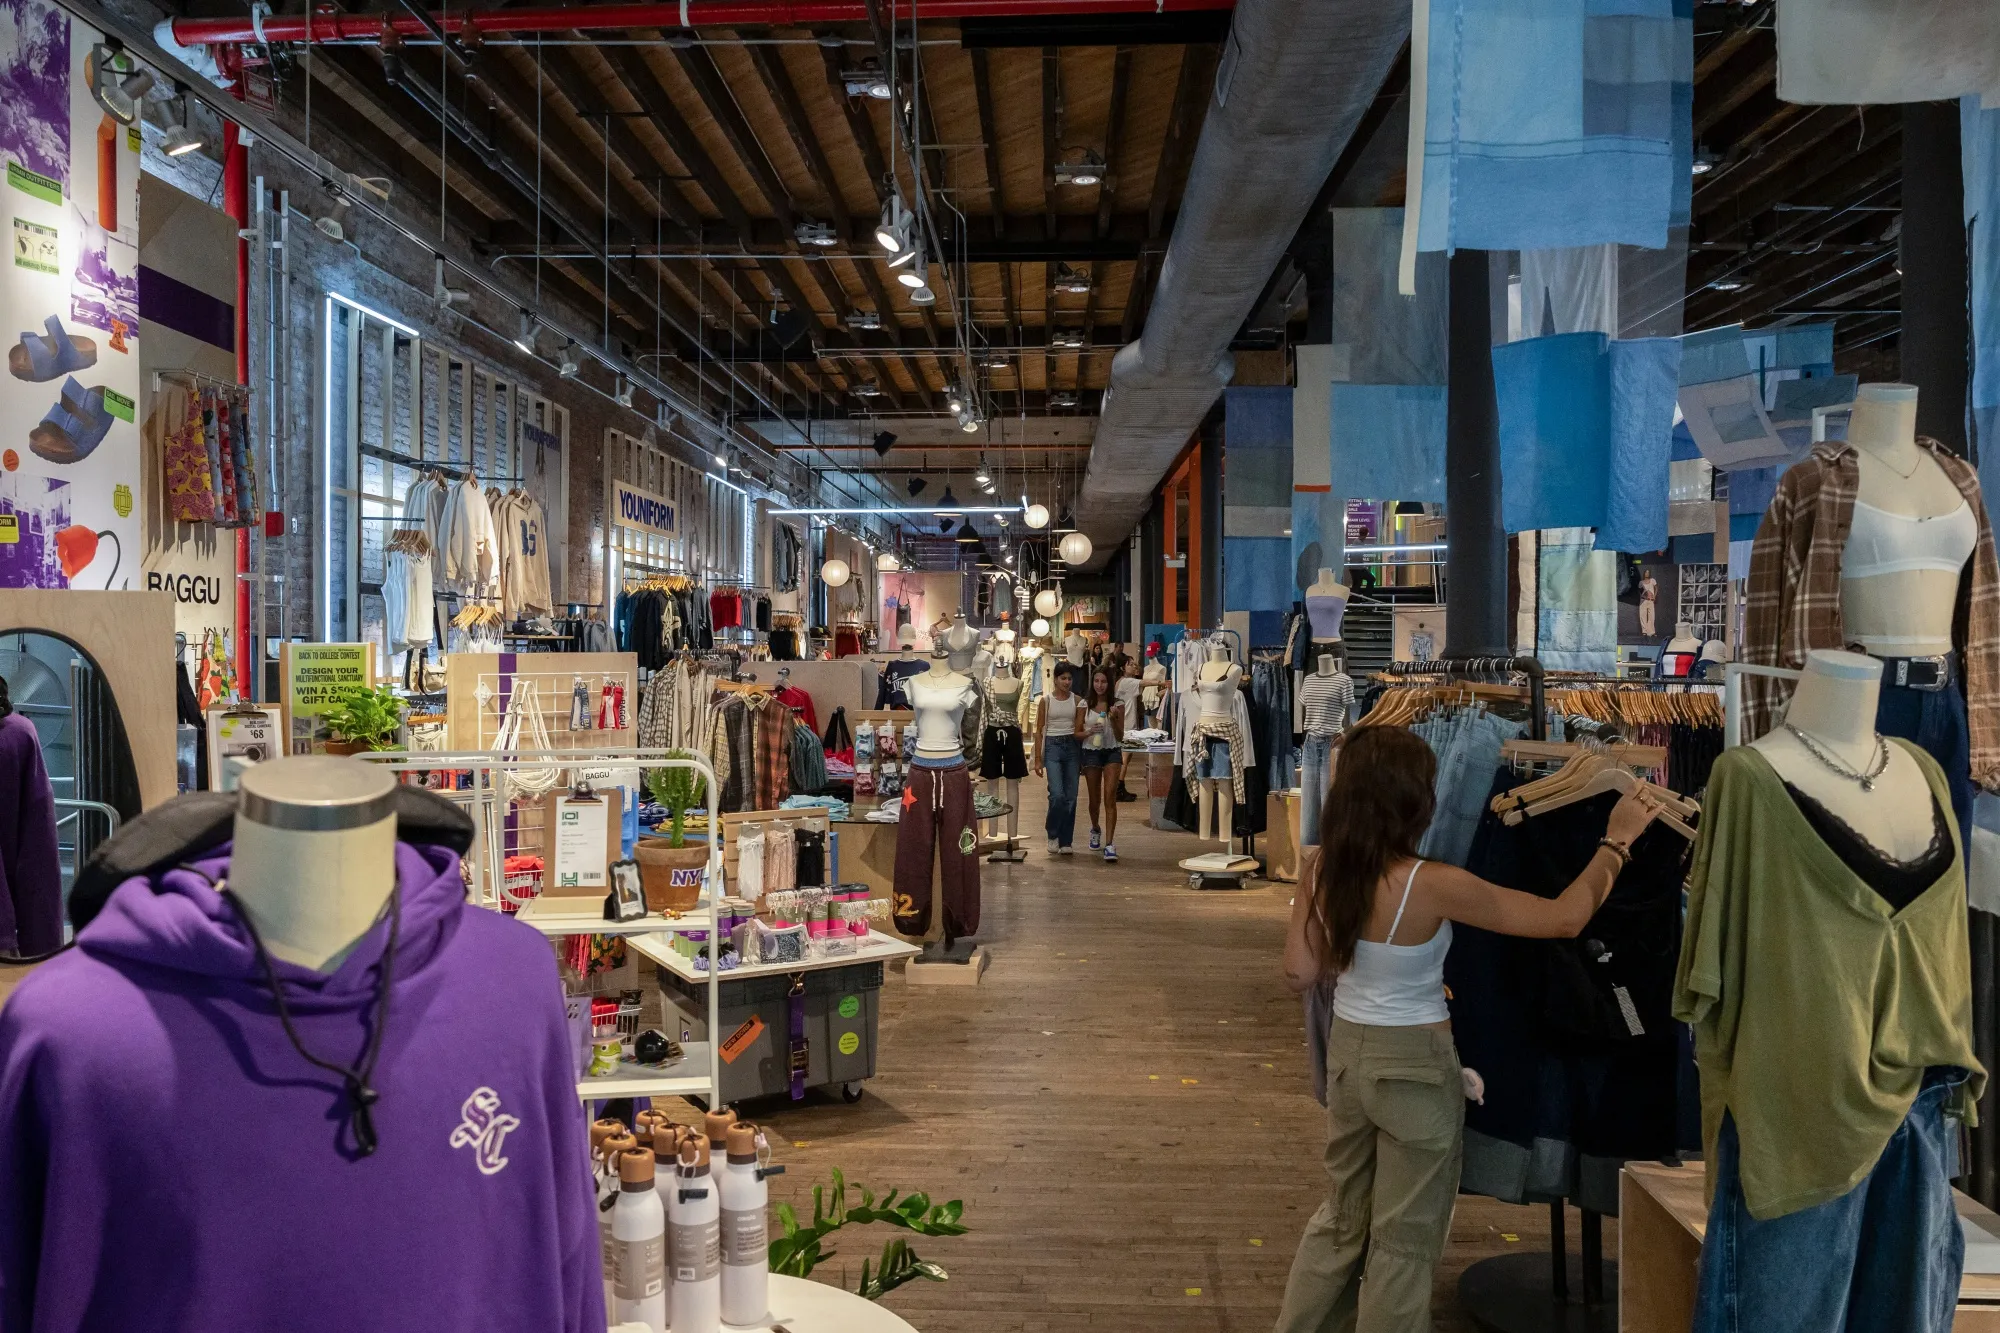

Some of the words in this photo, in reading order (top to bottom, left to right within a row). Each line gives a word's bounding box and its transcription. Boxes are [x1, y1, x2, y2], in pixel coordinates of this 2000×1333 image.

[26, 172, 61, 192] OUTFITTERS
[619, 489, 675, 533] YOUNIFORM
[148, 572, 220, 605] BAGGU
[299, 651, 312, 660] BACK
[312, 651, 319, 660] TO
[319, 651, 340, 660] COLLEGE
[340, 651, 361, 660] CONTEST
[301, 667, 333, 675] DESIGN
[295, 674, 336, 683] MULTIFUNCTIONAL
[337, 674, 364, 682] SANCTUARY
[296, 686, 318, 695] WIN
[320, 686, 328, 695] A
[302, 695, 326, 705] GIFT
[250, 729, 264, 739] $68
[585, 771, 610, 780] BAGGU
[724, 1036, 737, 1050] NEW
[736, 1022, 752, 1039] DORM
